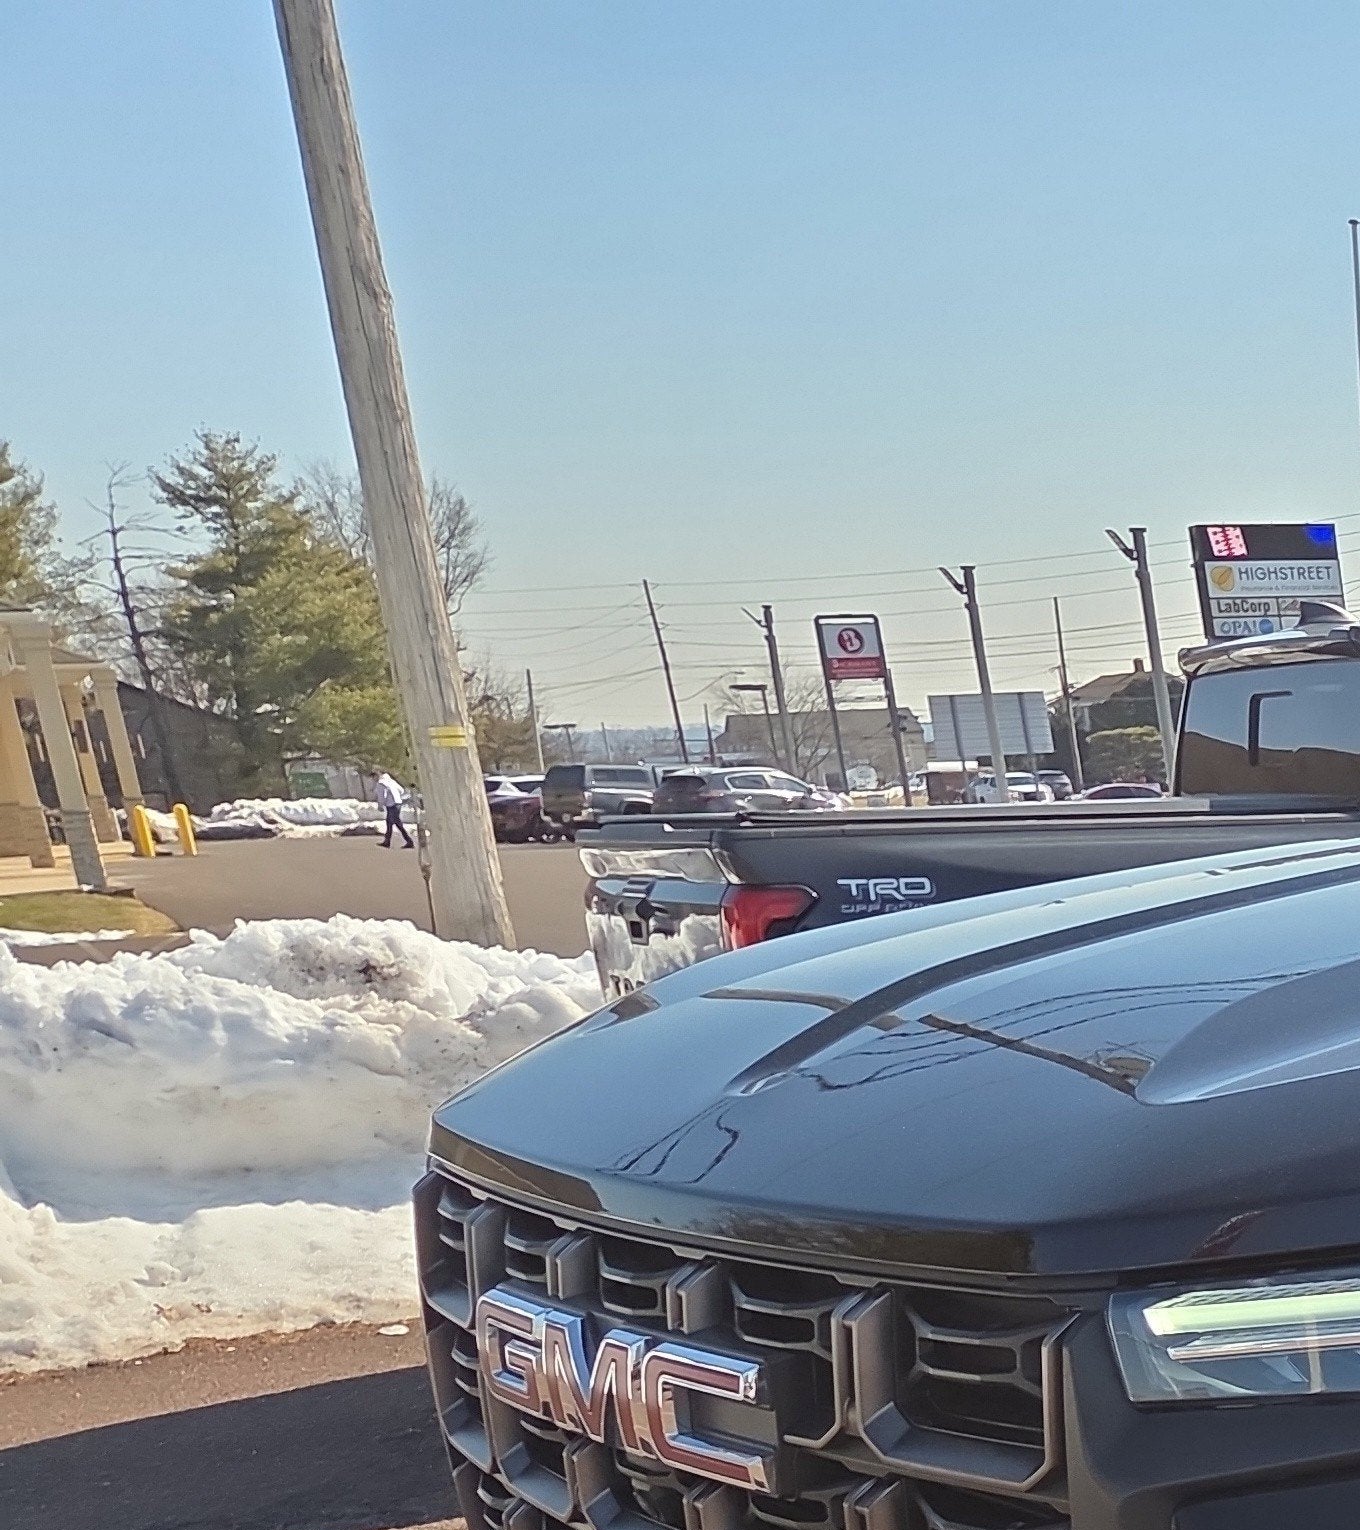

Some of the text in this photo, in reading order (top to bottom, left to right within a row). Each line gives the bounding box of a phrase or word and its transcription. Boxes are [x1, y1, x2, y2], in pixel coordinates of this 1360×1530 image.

[1238, 566, 1332, 581] HIGHSTREET
[1217, 600, 1270, 615] LabCorp
[837, 877, 932, 901] TRD
[476, 1289, 769, 1493] GMC
